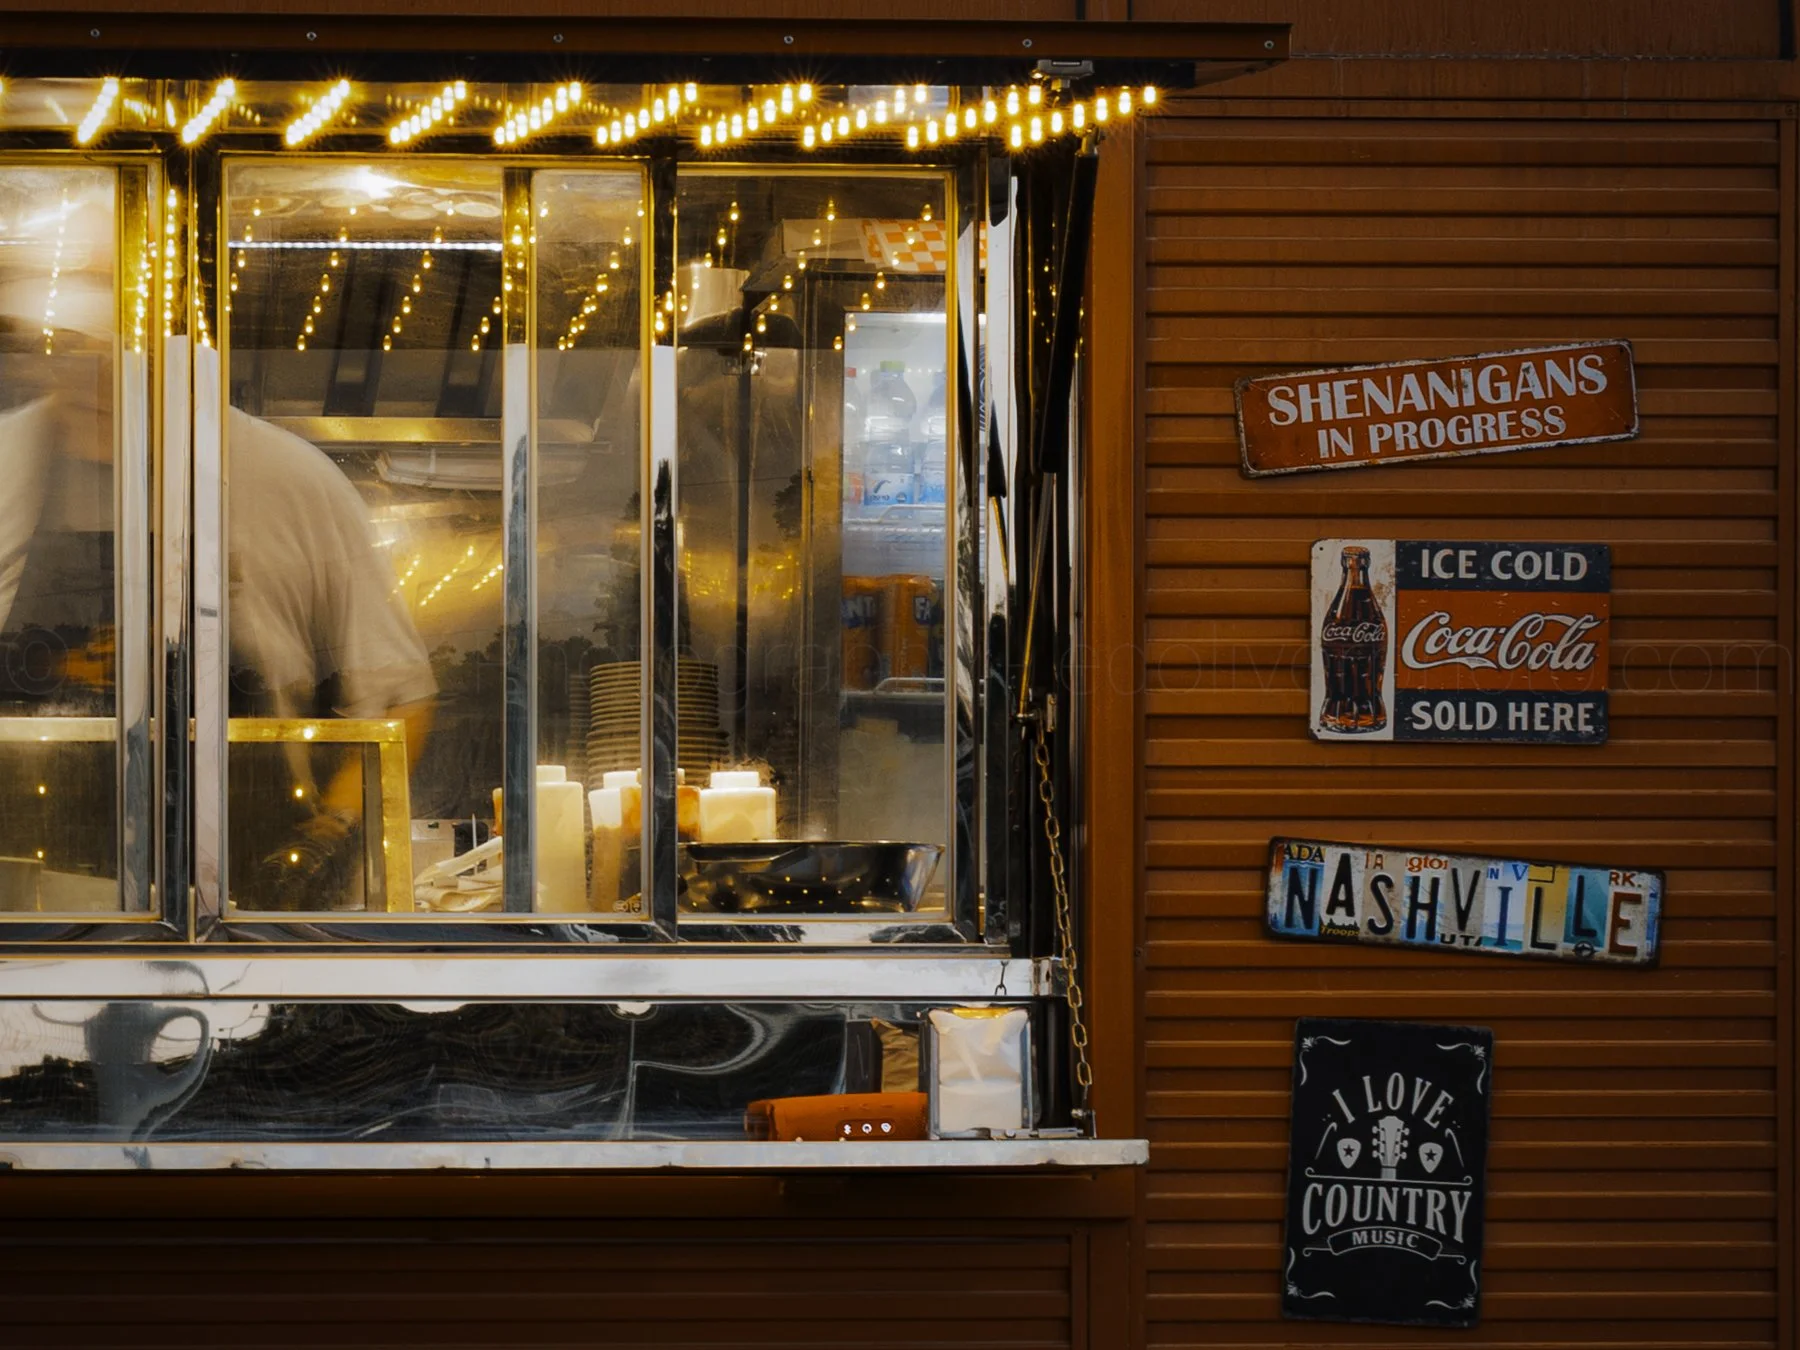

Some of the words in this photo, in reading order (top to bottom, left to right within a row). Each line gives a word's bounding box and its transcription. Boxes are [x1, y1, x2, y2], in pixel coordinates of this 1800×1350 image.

[1267, 354, 1608, 426] SHENANIGANS
[1317, 426, 1353, 459] IN
[1368, 405, 1567, 454] PROGRESS
[1421, 548, 1477, 580] ICE
[1491, 550, 1588, 581] COLD
[1401, 611, 1604, 671] Coca-Cola
[1411, 701, 1498, 731] SOLD
[1508, 702, 1594, 732] HERE
[1284, 852, 1643, 955] NASHVILLE
[1332, 1089, 1356, 1124] I
[1362, 1072, 1454, 1129] LOVE
[1302, 1182, 1473, 1244] COUNTRY
[1351, 1230, 1420, 1249] MUSIC
